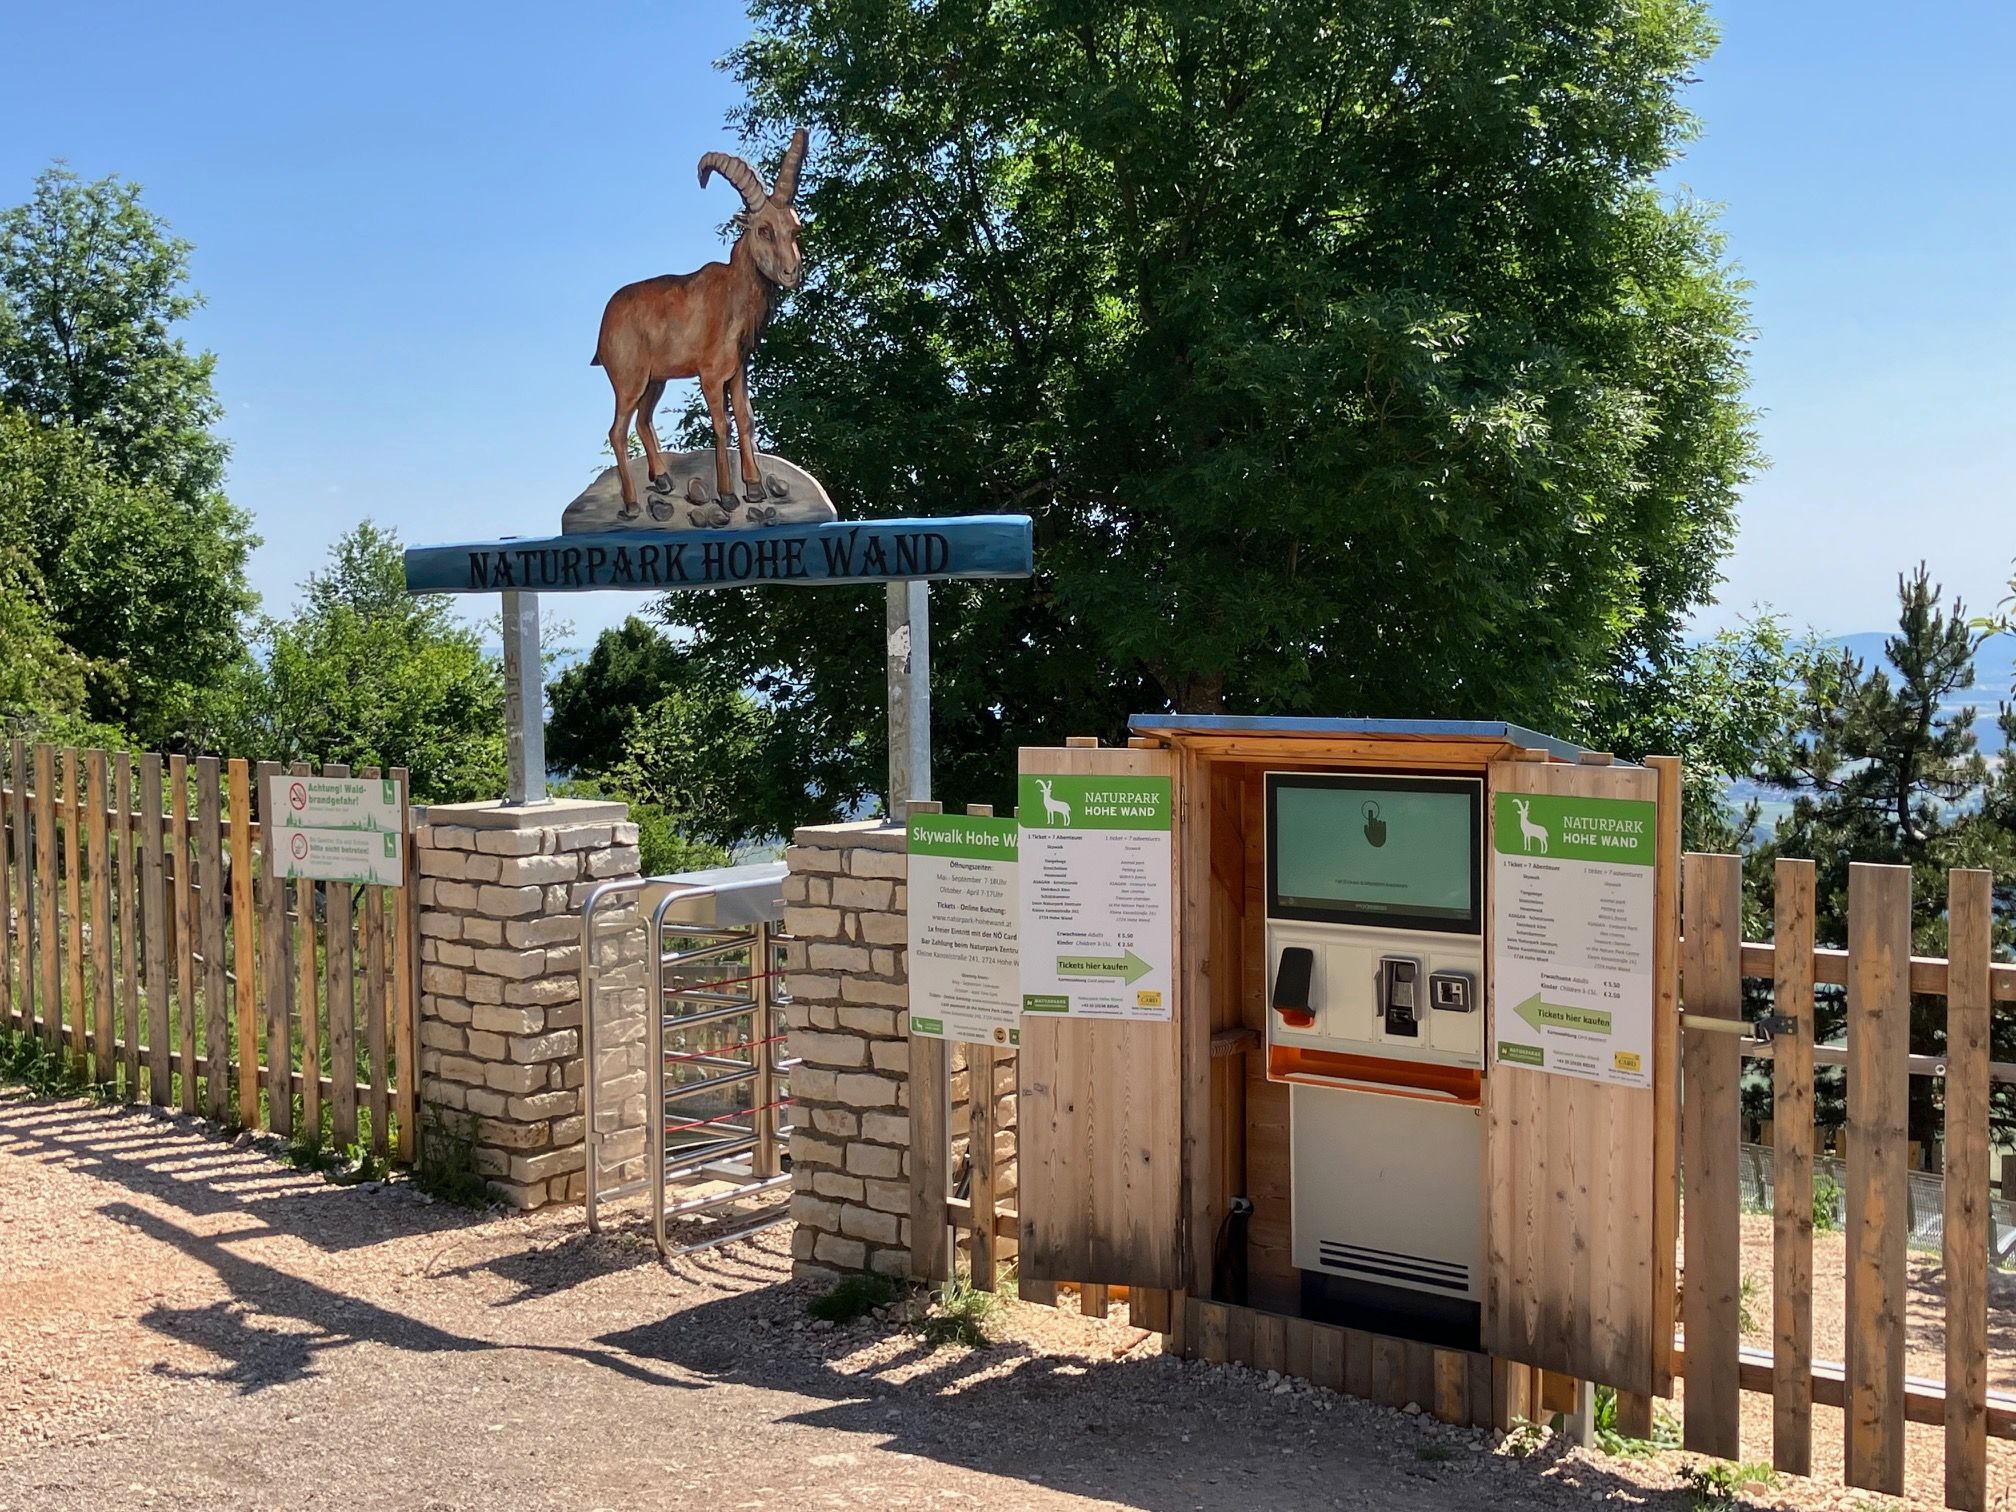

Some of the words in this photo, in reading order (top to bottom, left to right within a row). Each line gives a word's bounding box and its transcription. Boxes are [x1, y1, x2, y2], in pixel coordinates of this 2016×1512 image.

[467, 541, 690, 590] NATURPARK
[702, 538, 808, 581] HOHE
[819, 526, 951, 577] WAND
[308, 783, 342, 795] Achtung!
[344, 784, 366, 794] Wald-
[308, 795, 359, 806] brandgefahr!
[1085, 792, 1160, 804] NATURPARK
[1085, 807, 1117, 816] HOHE
[1120, 807, 1155, 817] WAND
[1563, 816, 1644, 834] NATURPARK
[913, 827, 962, 844] Skywalk
[966, 831, 999, 846] Hohe
[1003, 833, 1019, 847] W
[1563, 833, 1597, 845] HOHE
[1601, 836, 1638, 848] WAND
[952, 874, 981, 884] September
[940, 886, 962, 895] Oktober
[967, 888, 979, 897] April
[937, 902, 955, 910] Tickets
[960, 904, 979, 912] Online
[980, 905, 1006, 916] Buchung:
[982, 930, 992, 938] der
[993, 931, 1002, 939] NÖ
[1004, 932, 1018, 941] Card
[969, 942, 998, 952] Naturpark
[1059, 961, 1084, 970] Tickets
[1086, 962, 1101, 970] hier
[1102, 963, 1129, 971] kaufen
[1537, 1009, 1564, 1020] Tickets
[1566, 1012, 1582, 1022] hier
[1583, 1015, 1610, 1027] kaufen
